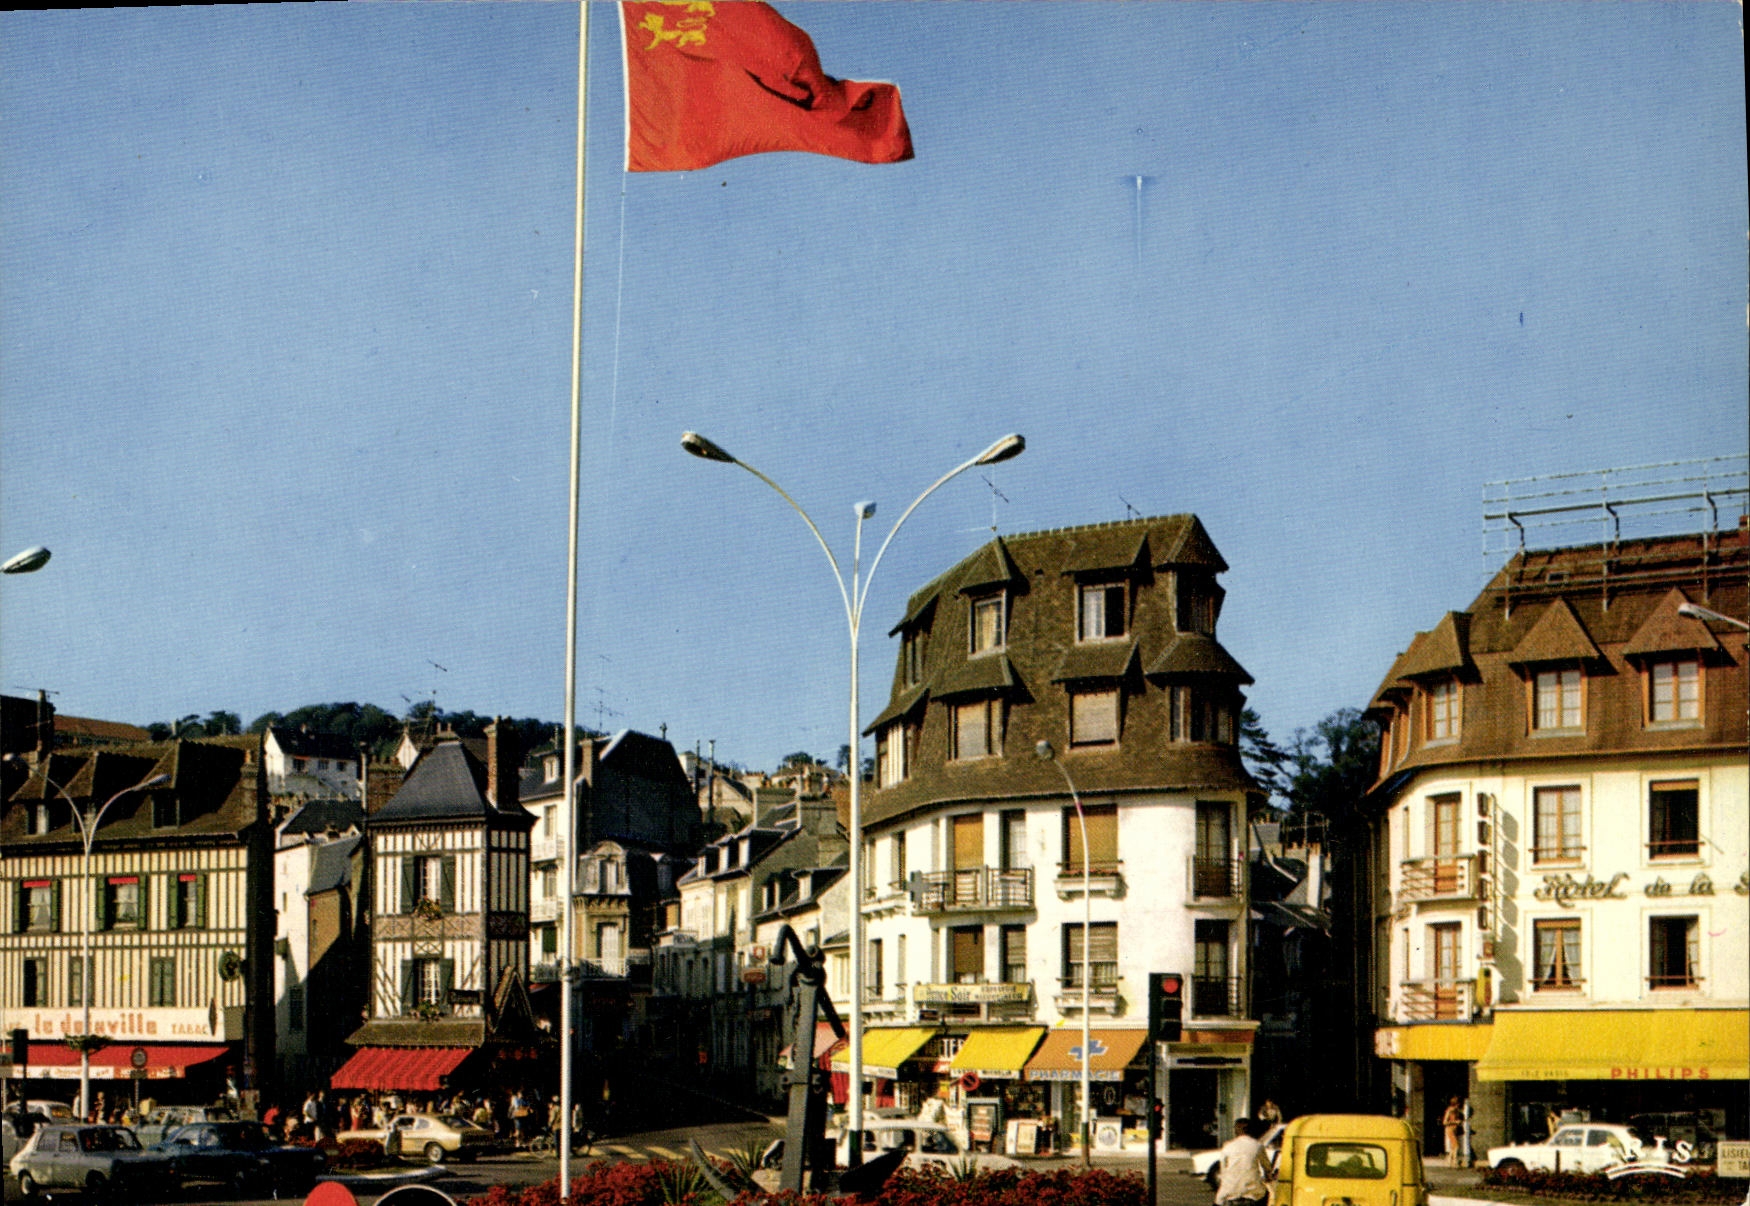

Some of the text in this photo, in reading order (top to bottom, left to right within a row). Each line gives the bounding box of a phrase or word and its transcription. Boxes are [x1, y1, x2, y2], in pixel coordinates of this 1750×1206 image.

[1688, 872, 1715, 896] la
[171, 1023, 209, 1035] TABAC
[1610, 1067, 1711, 1080] PHILIPS
